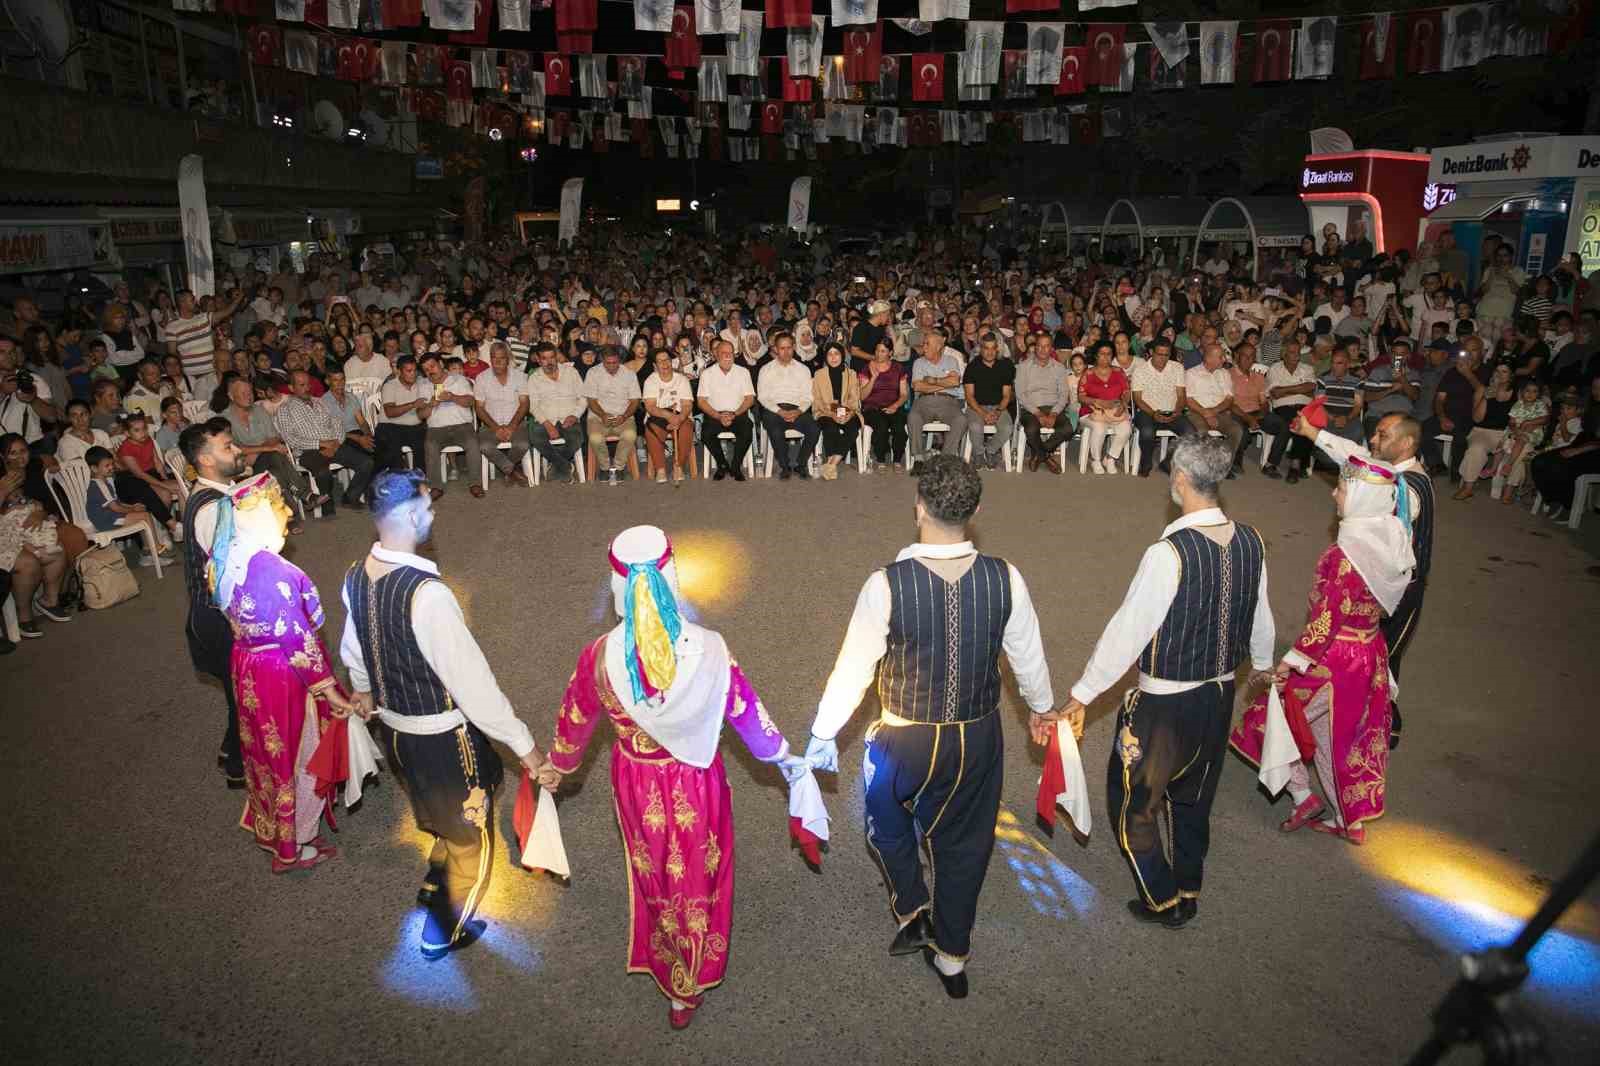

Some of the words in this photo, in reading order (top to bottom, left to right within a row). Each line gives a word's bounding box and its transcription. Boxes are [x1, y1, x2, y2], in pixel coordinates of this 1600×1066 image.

[1441, 153, 1509, 175] DenizBank
[1309, 170, 1328, 184] Ziraat
[1583, 214, 1600, 233] O
